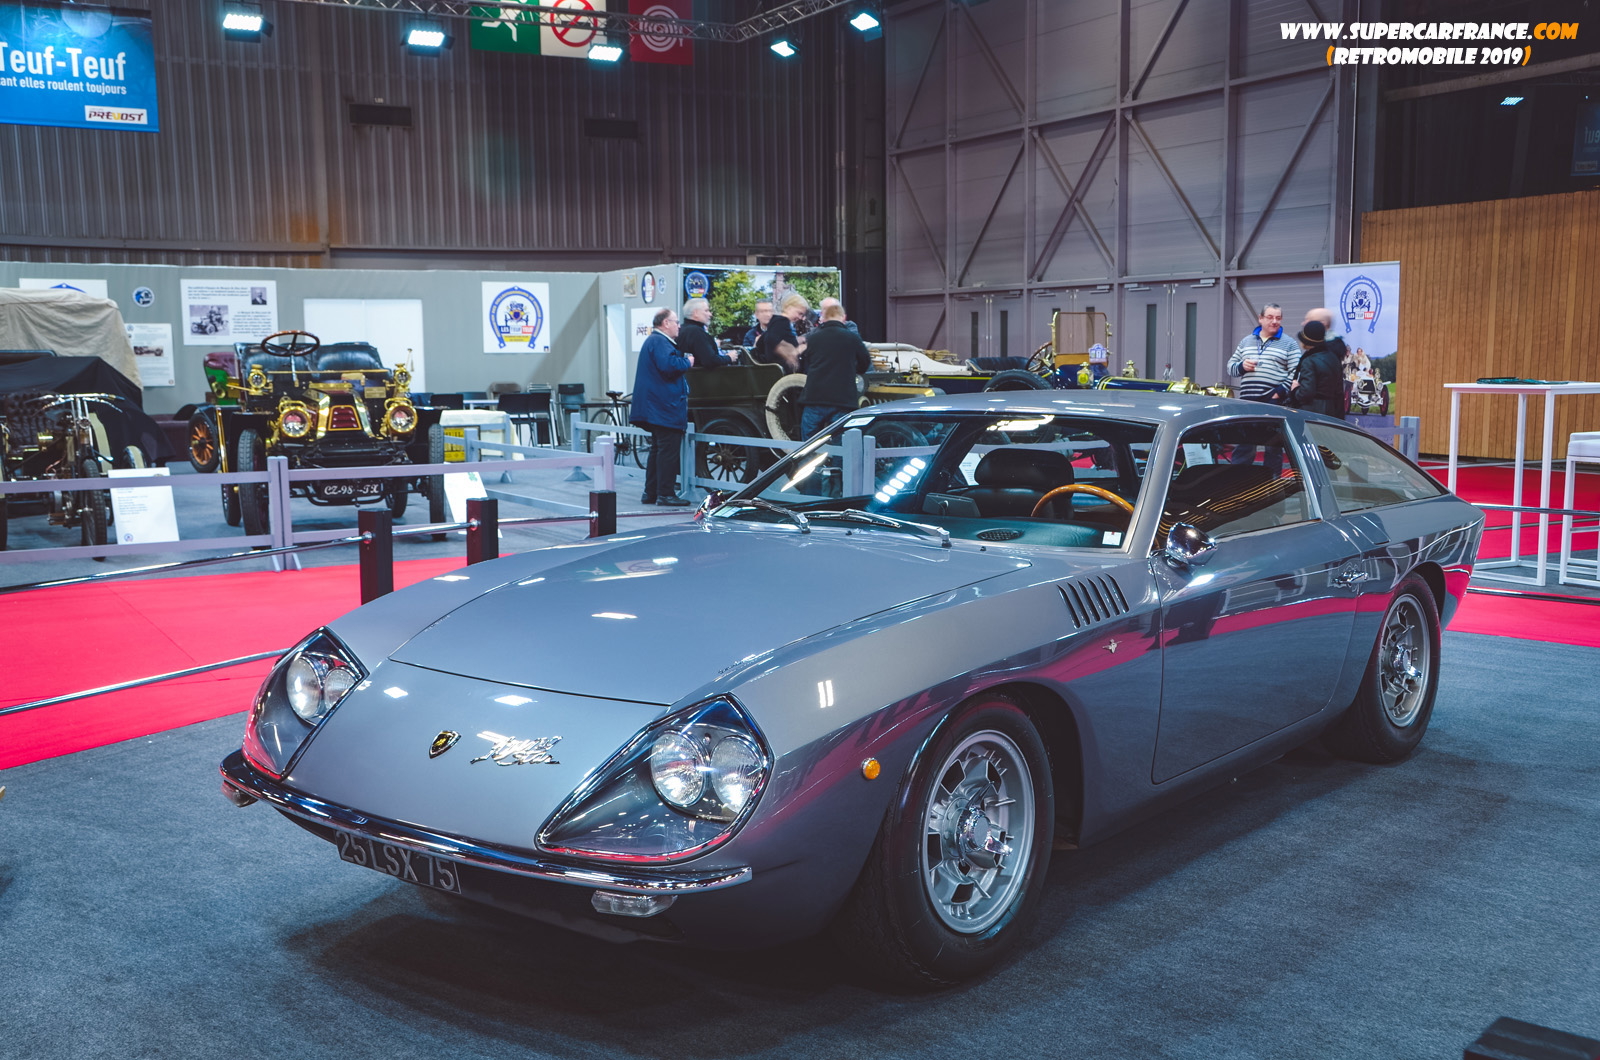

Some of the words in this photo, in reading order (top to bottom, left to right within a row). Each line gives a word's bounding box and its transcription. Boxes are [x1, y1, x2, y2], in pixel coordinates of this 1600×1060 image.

[0, 76, 18, 87] ant
[19, 76, 46, 90] elles
[47, 79, 85, 93] roulent
[86, 81, 127, 95] toujours
